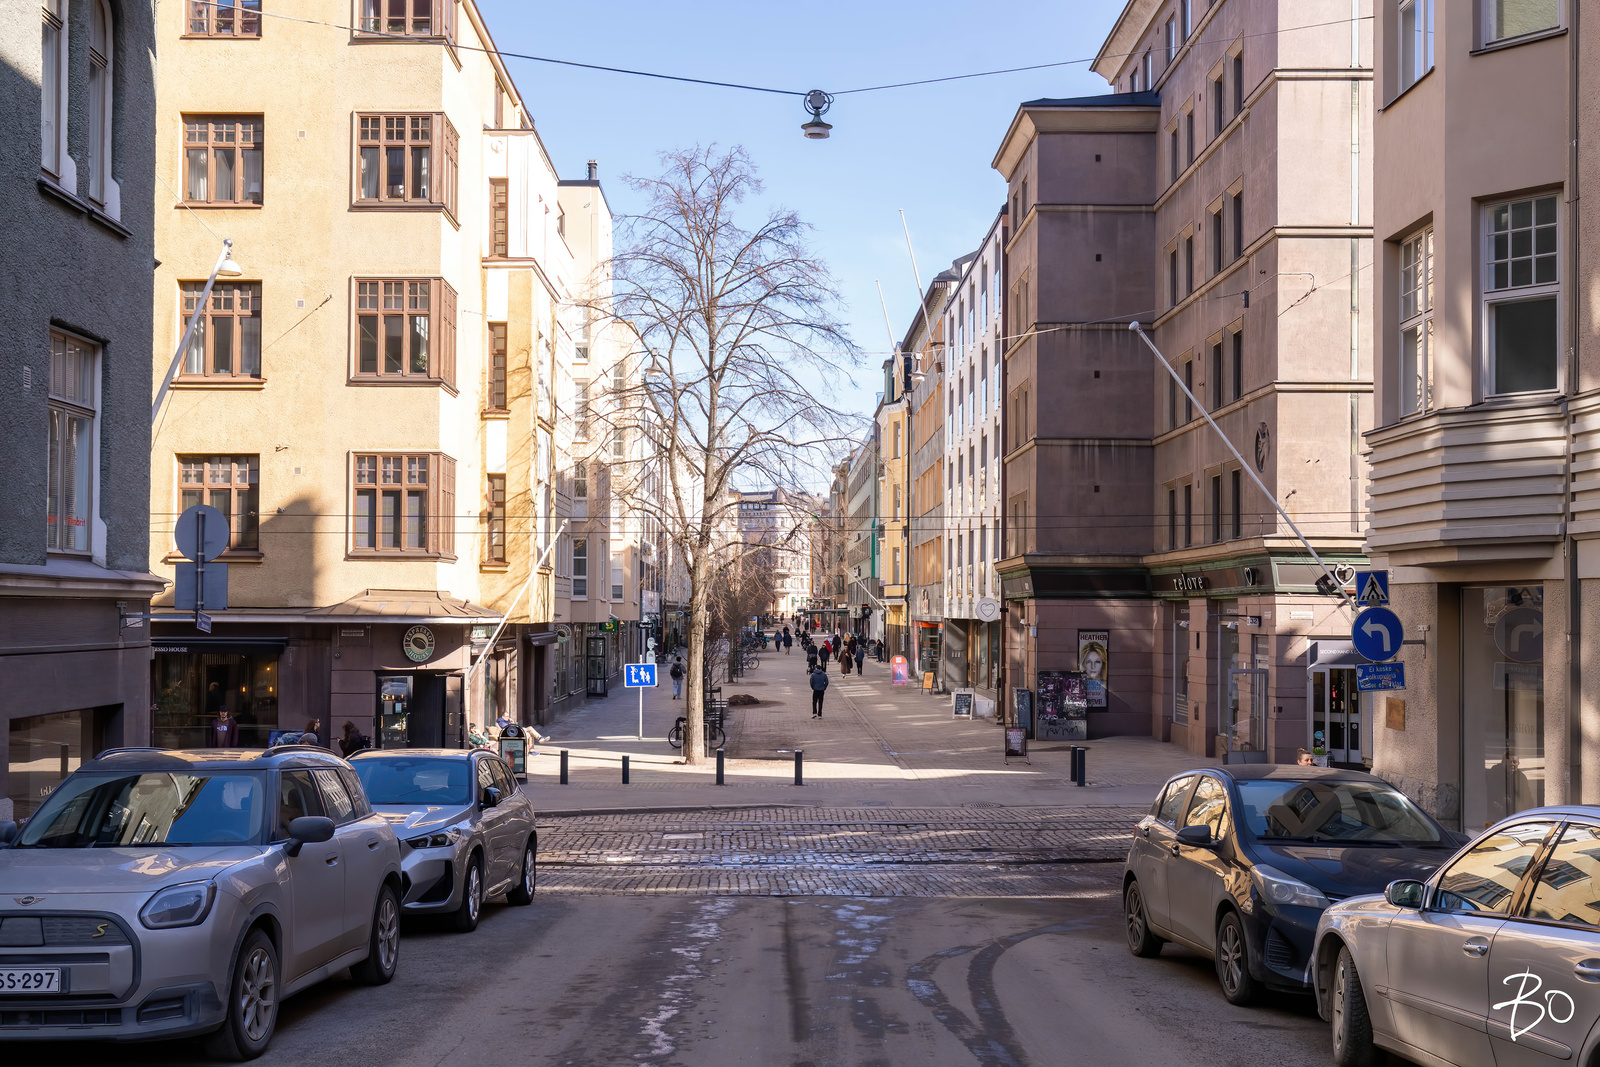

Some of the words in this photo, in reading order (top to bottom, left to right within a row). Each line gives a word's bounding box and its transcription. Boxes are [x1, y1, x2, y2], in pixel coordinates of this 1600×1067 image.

[1172, 573, 1204, 591] relove
[406, 627, 433, 641] ESPRESSO
[409, 650, 430, 660] HOUSE
